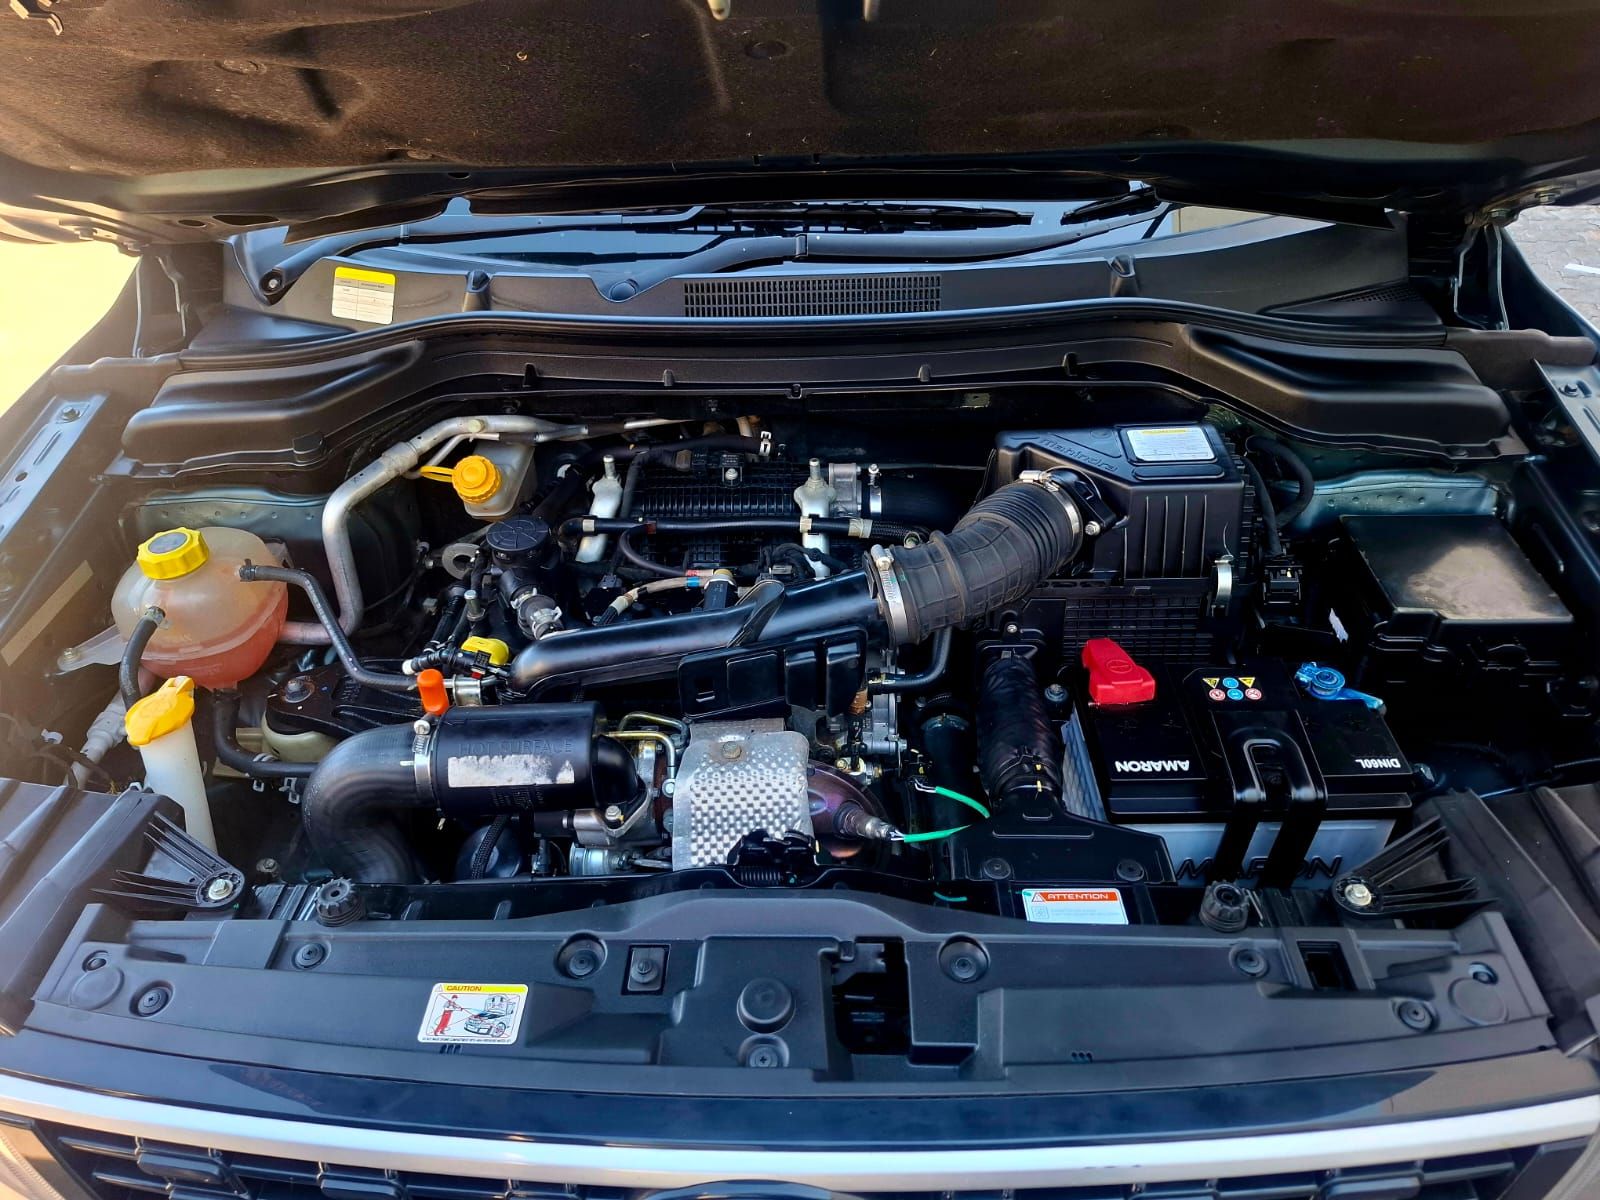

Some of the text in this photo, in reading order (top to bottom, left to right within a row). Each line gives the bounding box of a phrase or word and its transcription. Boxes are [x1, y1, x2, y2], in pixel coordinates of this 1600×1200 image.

[458, 738, 572, 756] HOT SURFACE
[1115, 760, 1190, 772] AMARON
[1355, 758, 1401, 769] DIN60L
